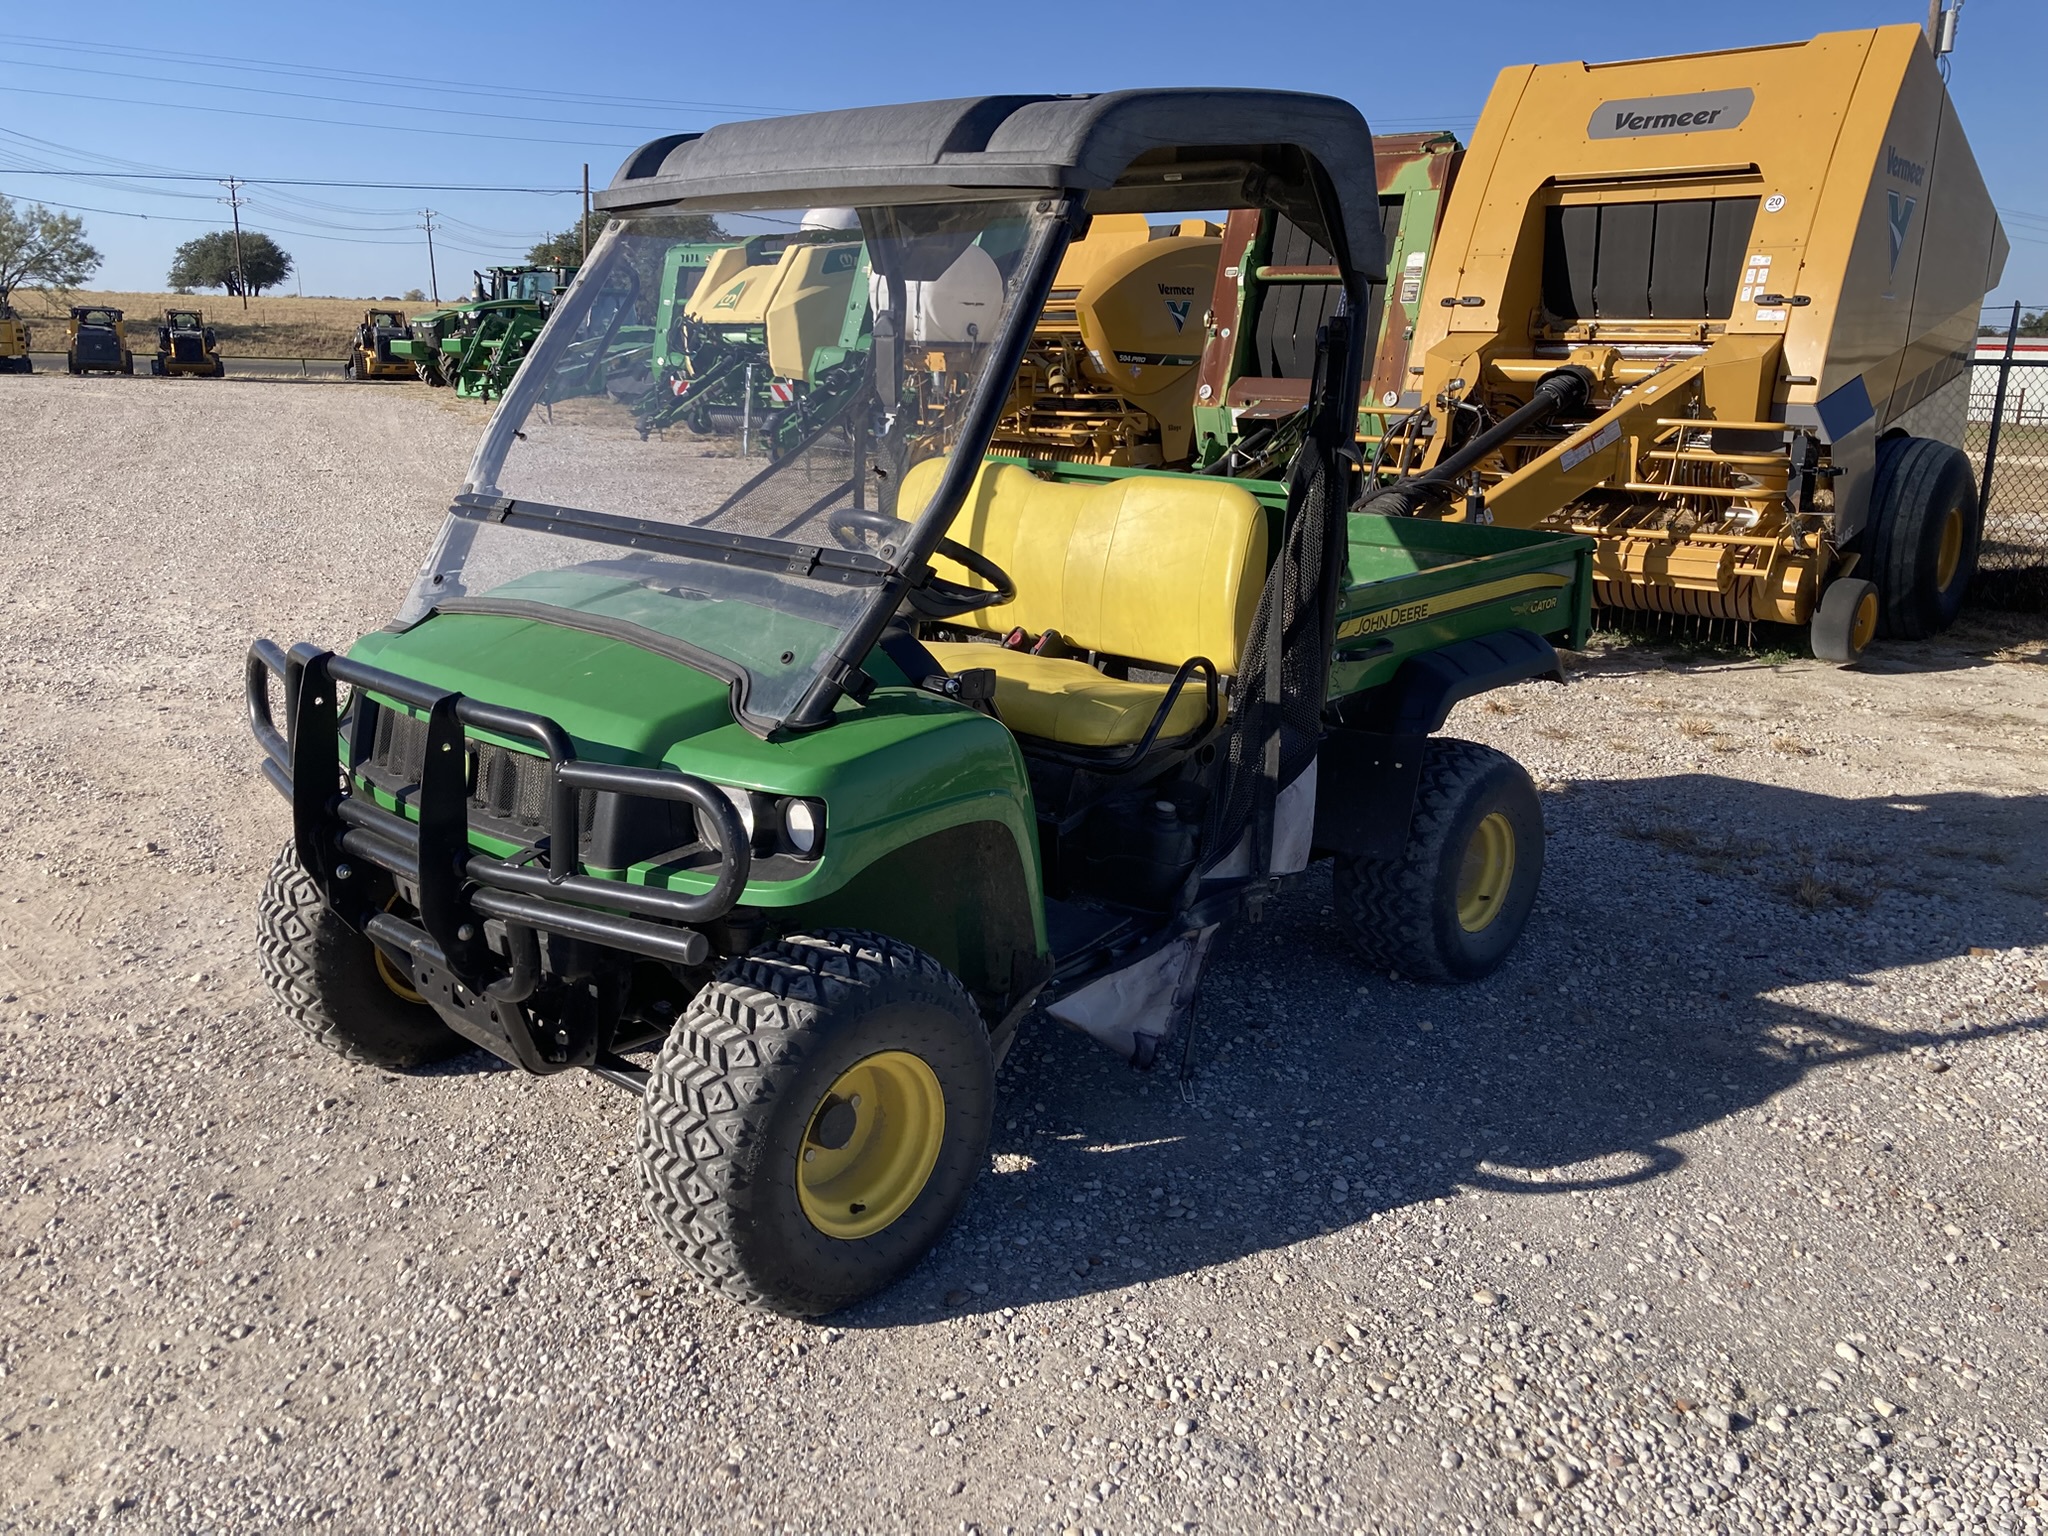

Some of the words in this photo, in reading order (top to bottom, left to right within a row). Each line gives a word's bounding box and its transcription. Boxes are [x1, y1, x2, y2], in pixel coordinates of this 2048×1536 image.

[1614, 109, 1722, 131] Vermeer
[1886, 145, 1925, 187] Vermeer
[1768, 197, 1782, 206] 20
[1157, 283, 1195, 295] Vermeer
[1530, 597, 1557, 613] GATOR
[1354, 613, 1388, 635] JOHN
[1391, 603, 1429, 625] DEERE
